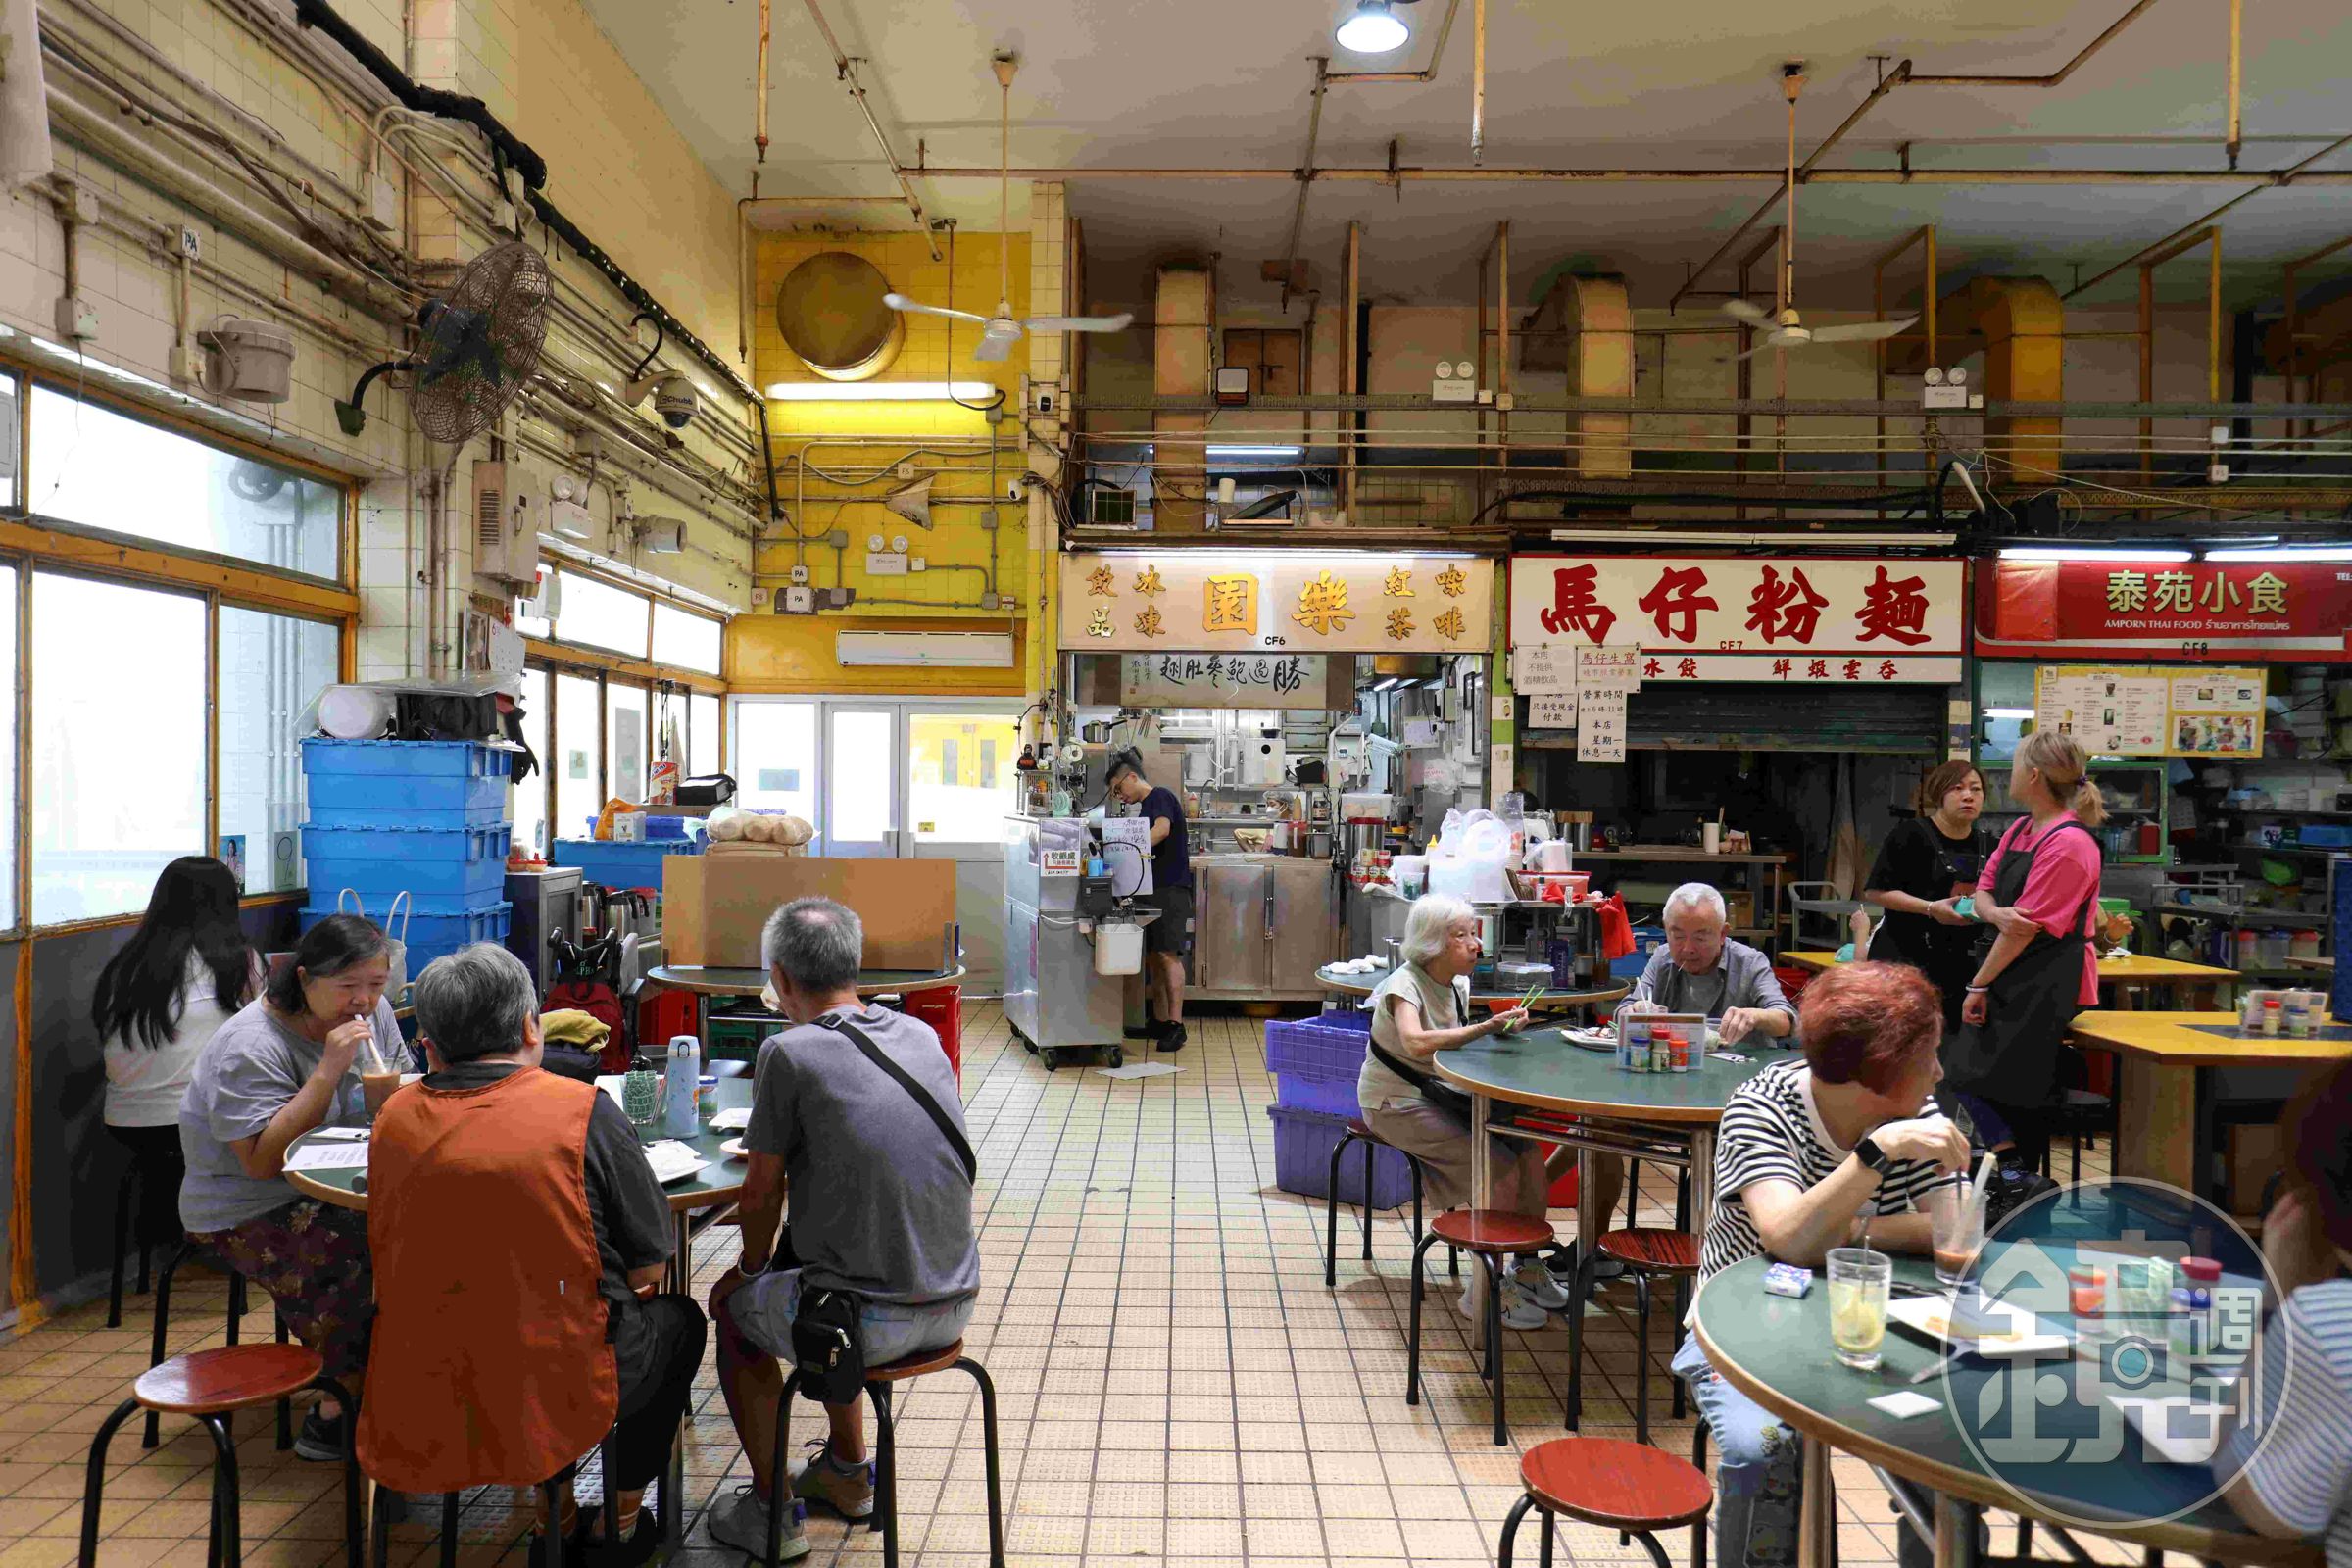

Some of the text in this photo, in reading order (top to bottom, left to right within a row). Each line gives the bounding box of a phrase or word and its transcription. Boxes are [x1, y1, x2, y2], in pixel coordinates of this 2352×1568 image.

[184, 231, 198, 252] PA
[2105, 569, 2289, 614] 泰苑小食
[1540, 563, 1933, 645] 馬仔粉麵
[2104, 619, 2147, 629] AMPORN
[2148, 619, 2171, 629] THAI
[2173, 619, 2203, 630] FOOD
[1264, 636, 1286, 646] CF6
[1719, 640, 1743, 651] CF7
[2181, 641, 2209, 656] CF8
[1643, 657, 1699, 679] 水餃
[1583, 689, 1623, 700] 營業時間
[1532, 703, 1575, 711] 只接受現金
[1543, 712, 1563, 722] 付款
[1592, 719, 1612, 730] 本店
[1592, 735, 1623, 746] 星期一
[1582, 747, 1622, 758] 休息一天
